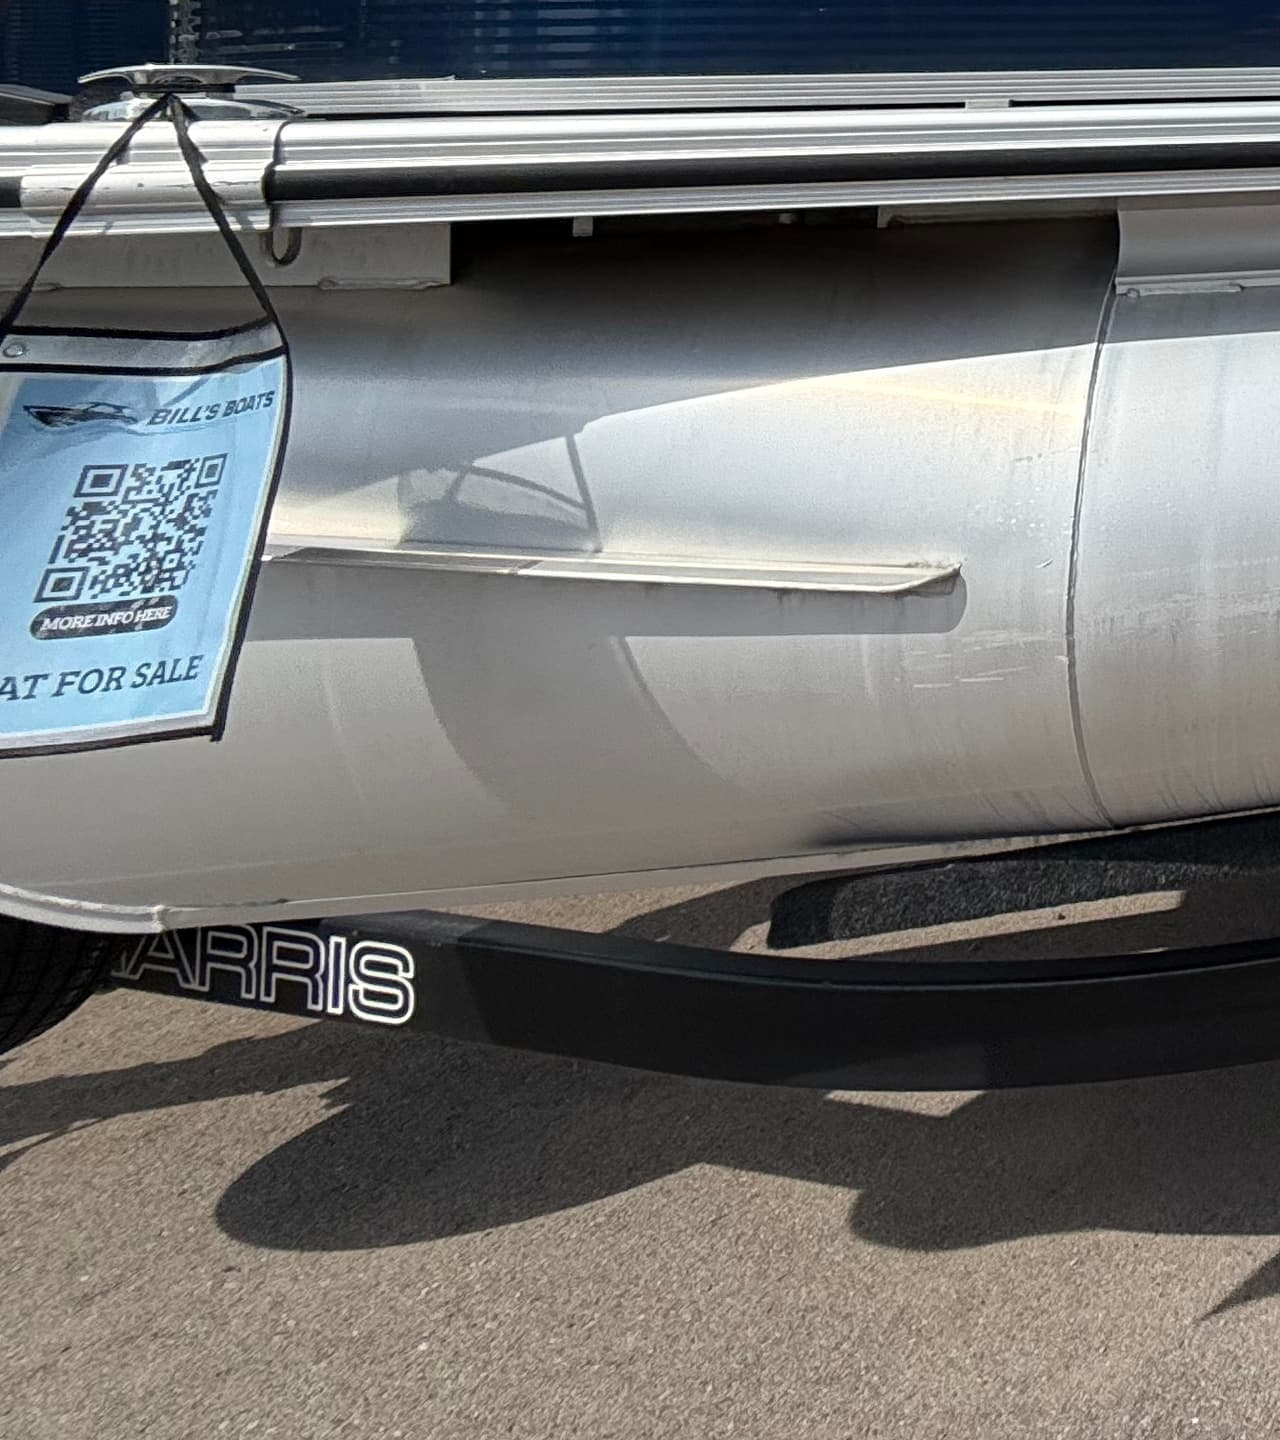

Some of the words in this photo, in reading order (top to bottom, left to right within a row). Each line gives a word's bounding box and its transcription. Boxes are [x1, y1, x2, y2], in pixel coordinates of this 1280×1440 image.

[147, 403, 221, 426] BILL'S
[221, 390, 275, 418] BOATS
[40, 614, 95, 631] MORE
[94, 610, 134, 627] INFO
[135, 605, 173, 622] HERE
[51, 666, 127, 698] FOR
[131, 654, 204, 689] SALE
[110, 924, 416, 1025] ARRIS
